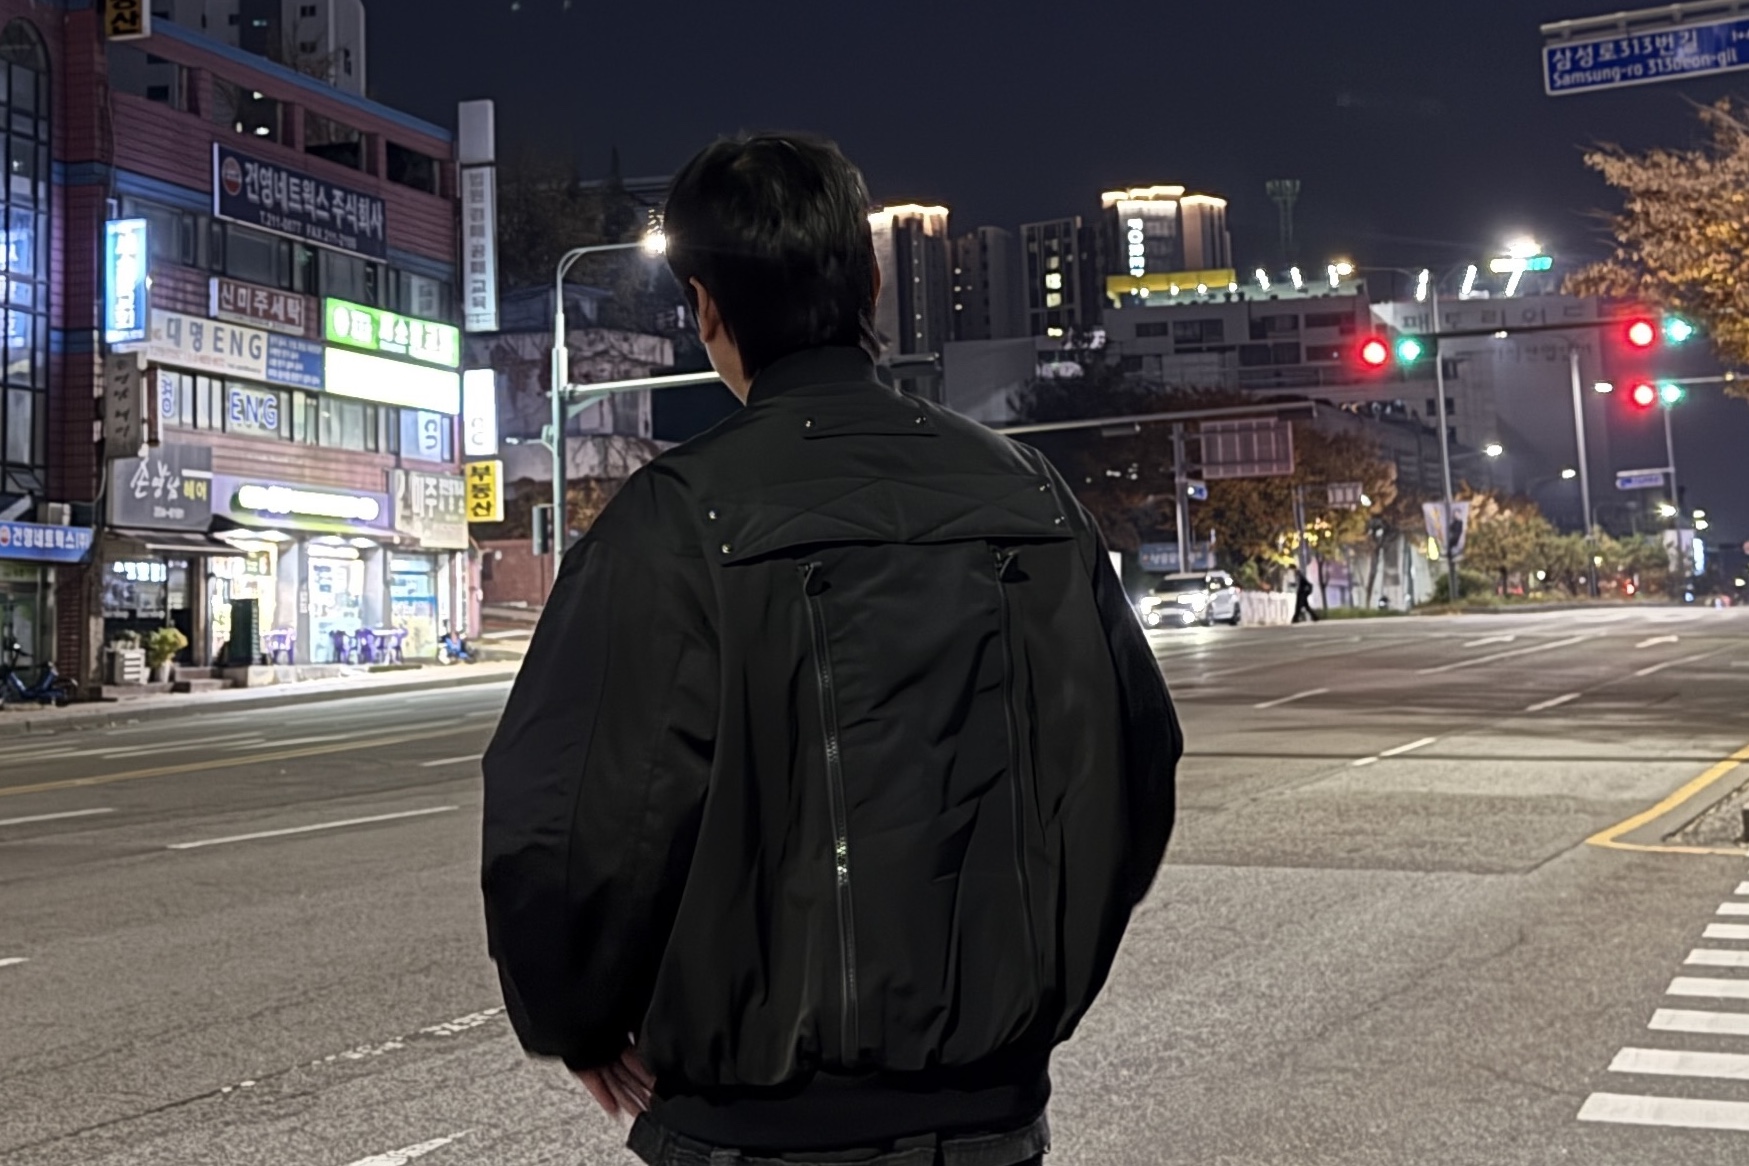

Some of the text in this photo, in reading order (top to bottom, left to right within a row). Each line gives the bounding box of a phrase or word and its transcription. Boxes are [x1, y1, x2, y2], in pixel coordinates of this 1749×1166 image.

[1552, 63, 1643, 88] Samsung-ro
[244, 162, 384, 241] 건영네트웍스 주식회사
[221, 283, 302, 326] 신미주세탁
[230, 389, 278, 428] ENG
[183, 479, 208, 501] 헤어
[471, 465, 492, 518] 부동산
